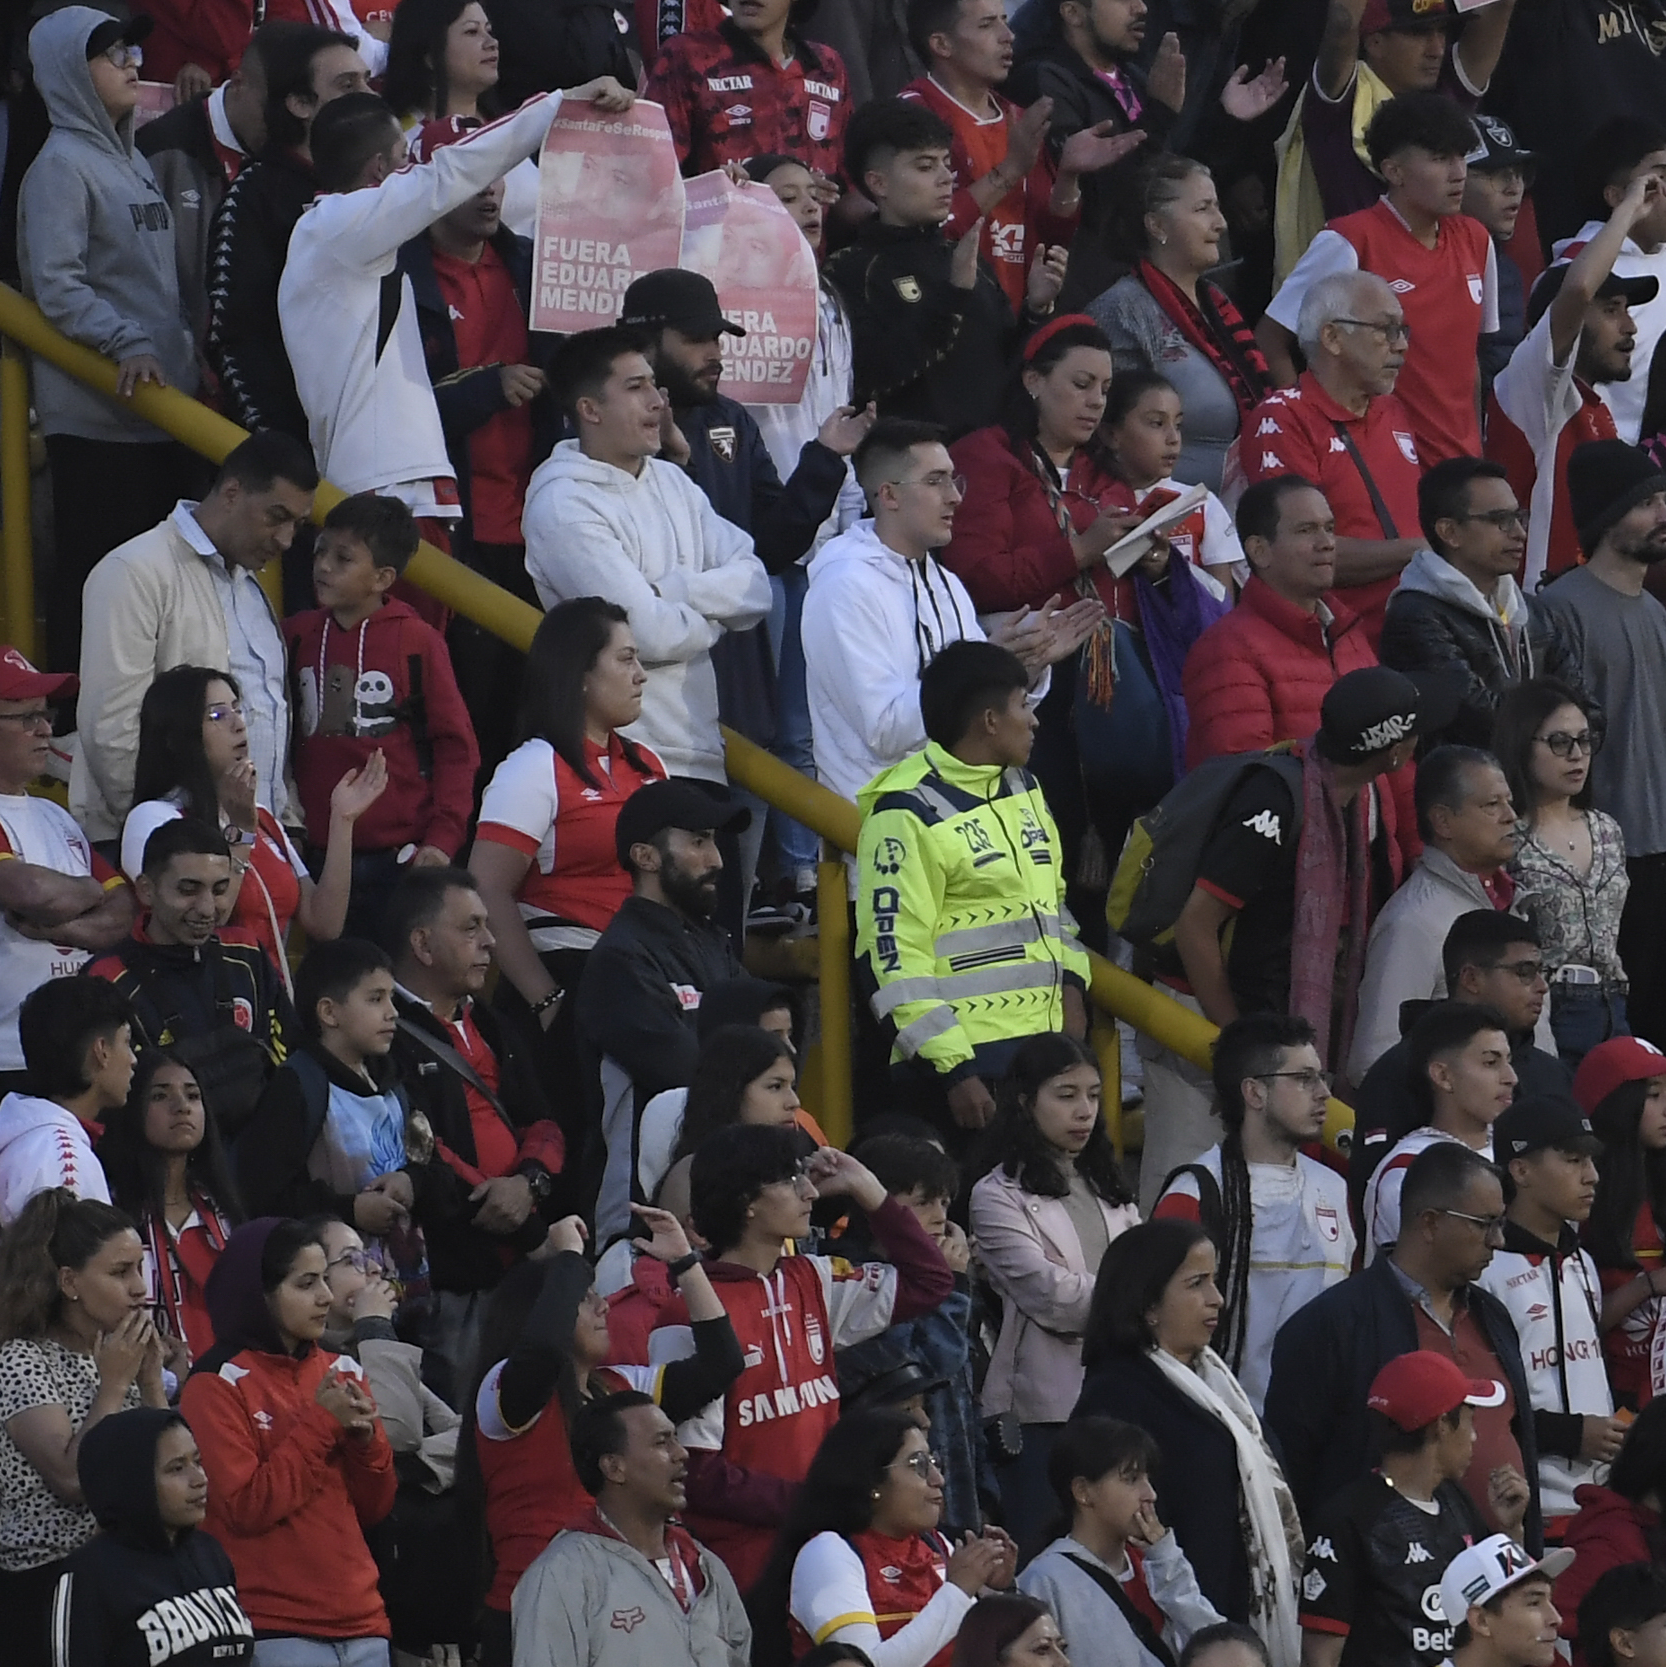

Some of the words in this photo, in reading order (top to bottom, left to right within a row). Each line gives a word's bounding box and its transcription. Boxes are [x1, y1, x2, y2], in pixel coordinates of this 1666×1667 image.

[707, 75, 753, 92] NECTAR
[803, 78, 840, 102] NECTAR
[543, 237, 631, 266] FUERA
[541, 261, 641, 291] EDUAR
[540, 287, 625, 315] MEND
[719, 335, 811, 360] DUARDO
[720, 359, 795, 384] ENDEZ
[872, 886, 901, 974] OPEN
